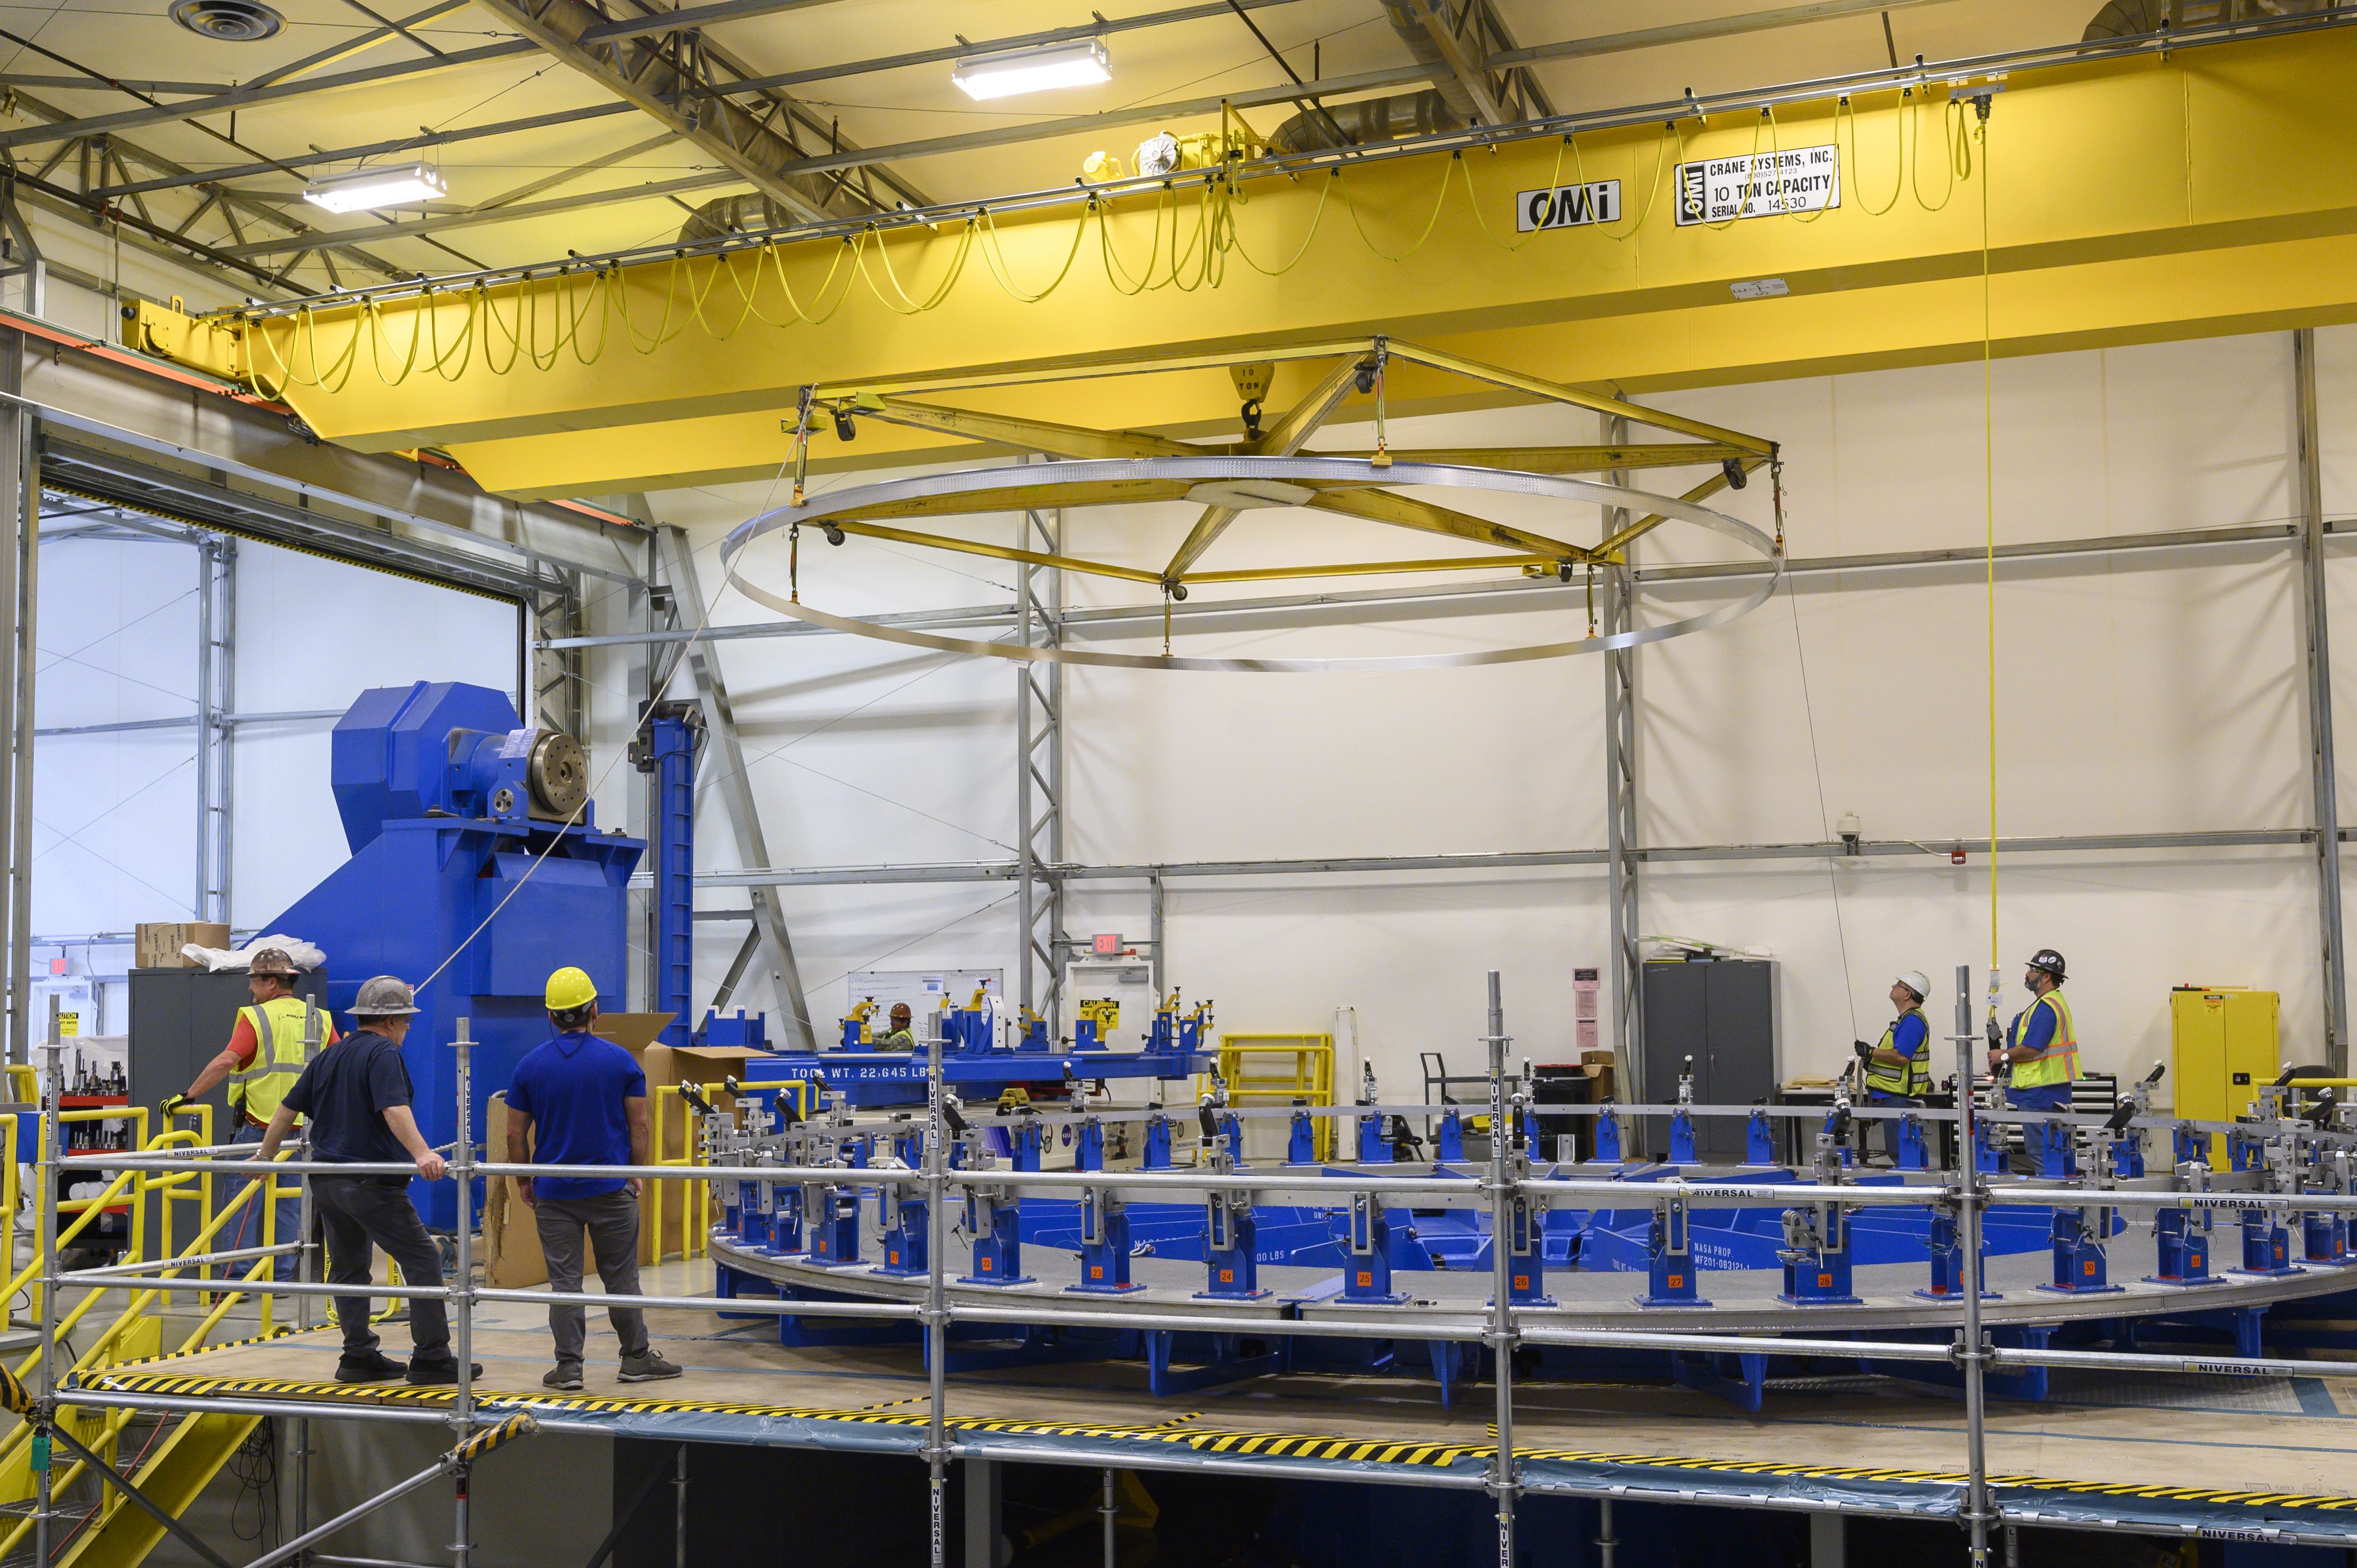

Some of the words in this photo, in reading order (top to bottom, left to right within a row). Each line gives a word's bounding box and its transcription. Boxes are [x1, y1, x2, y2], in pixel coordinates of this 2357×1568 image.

[1710, 160, 1746, 176] CRANE
[1751, 154, 1805, 171] SYSTEMS,
[1810, 150, 1833, 164] INC.
[1745, 168, 1797, 181] (800)5274123
[1714, 187, 1729, 202] 10
[1736, 182, 1762, 200] TON
[1766, 174, 1830, 196] CAPACITY
[1712, 206, 1738, 218] SERIAL
[1743, 202, 1755, 214] NO.
[1769, 196, 1806, 211] 14530
[1239, 382, 1259, 390] TON
[1096, 935, 1116, 952] EXIT
[52, 959, 66, 974] EXIT
[832, 1068, 854, 1078] WT.
[860, 1067, 907, 1078] 22,645
[912, 1067, 928, 1077] LB
[2182, 1199, 2265, 1208] UNIVERSAL
[1255, 1253, 1267, 1262] 00
[1270, 1250, 1285, 1261] LBS
[1694, 1242, 1712, 1254] NASA
[1714, 1245, 1734, 1258] PROP.
[2186, 1363, 2270, 1375] UNIVERSAL
